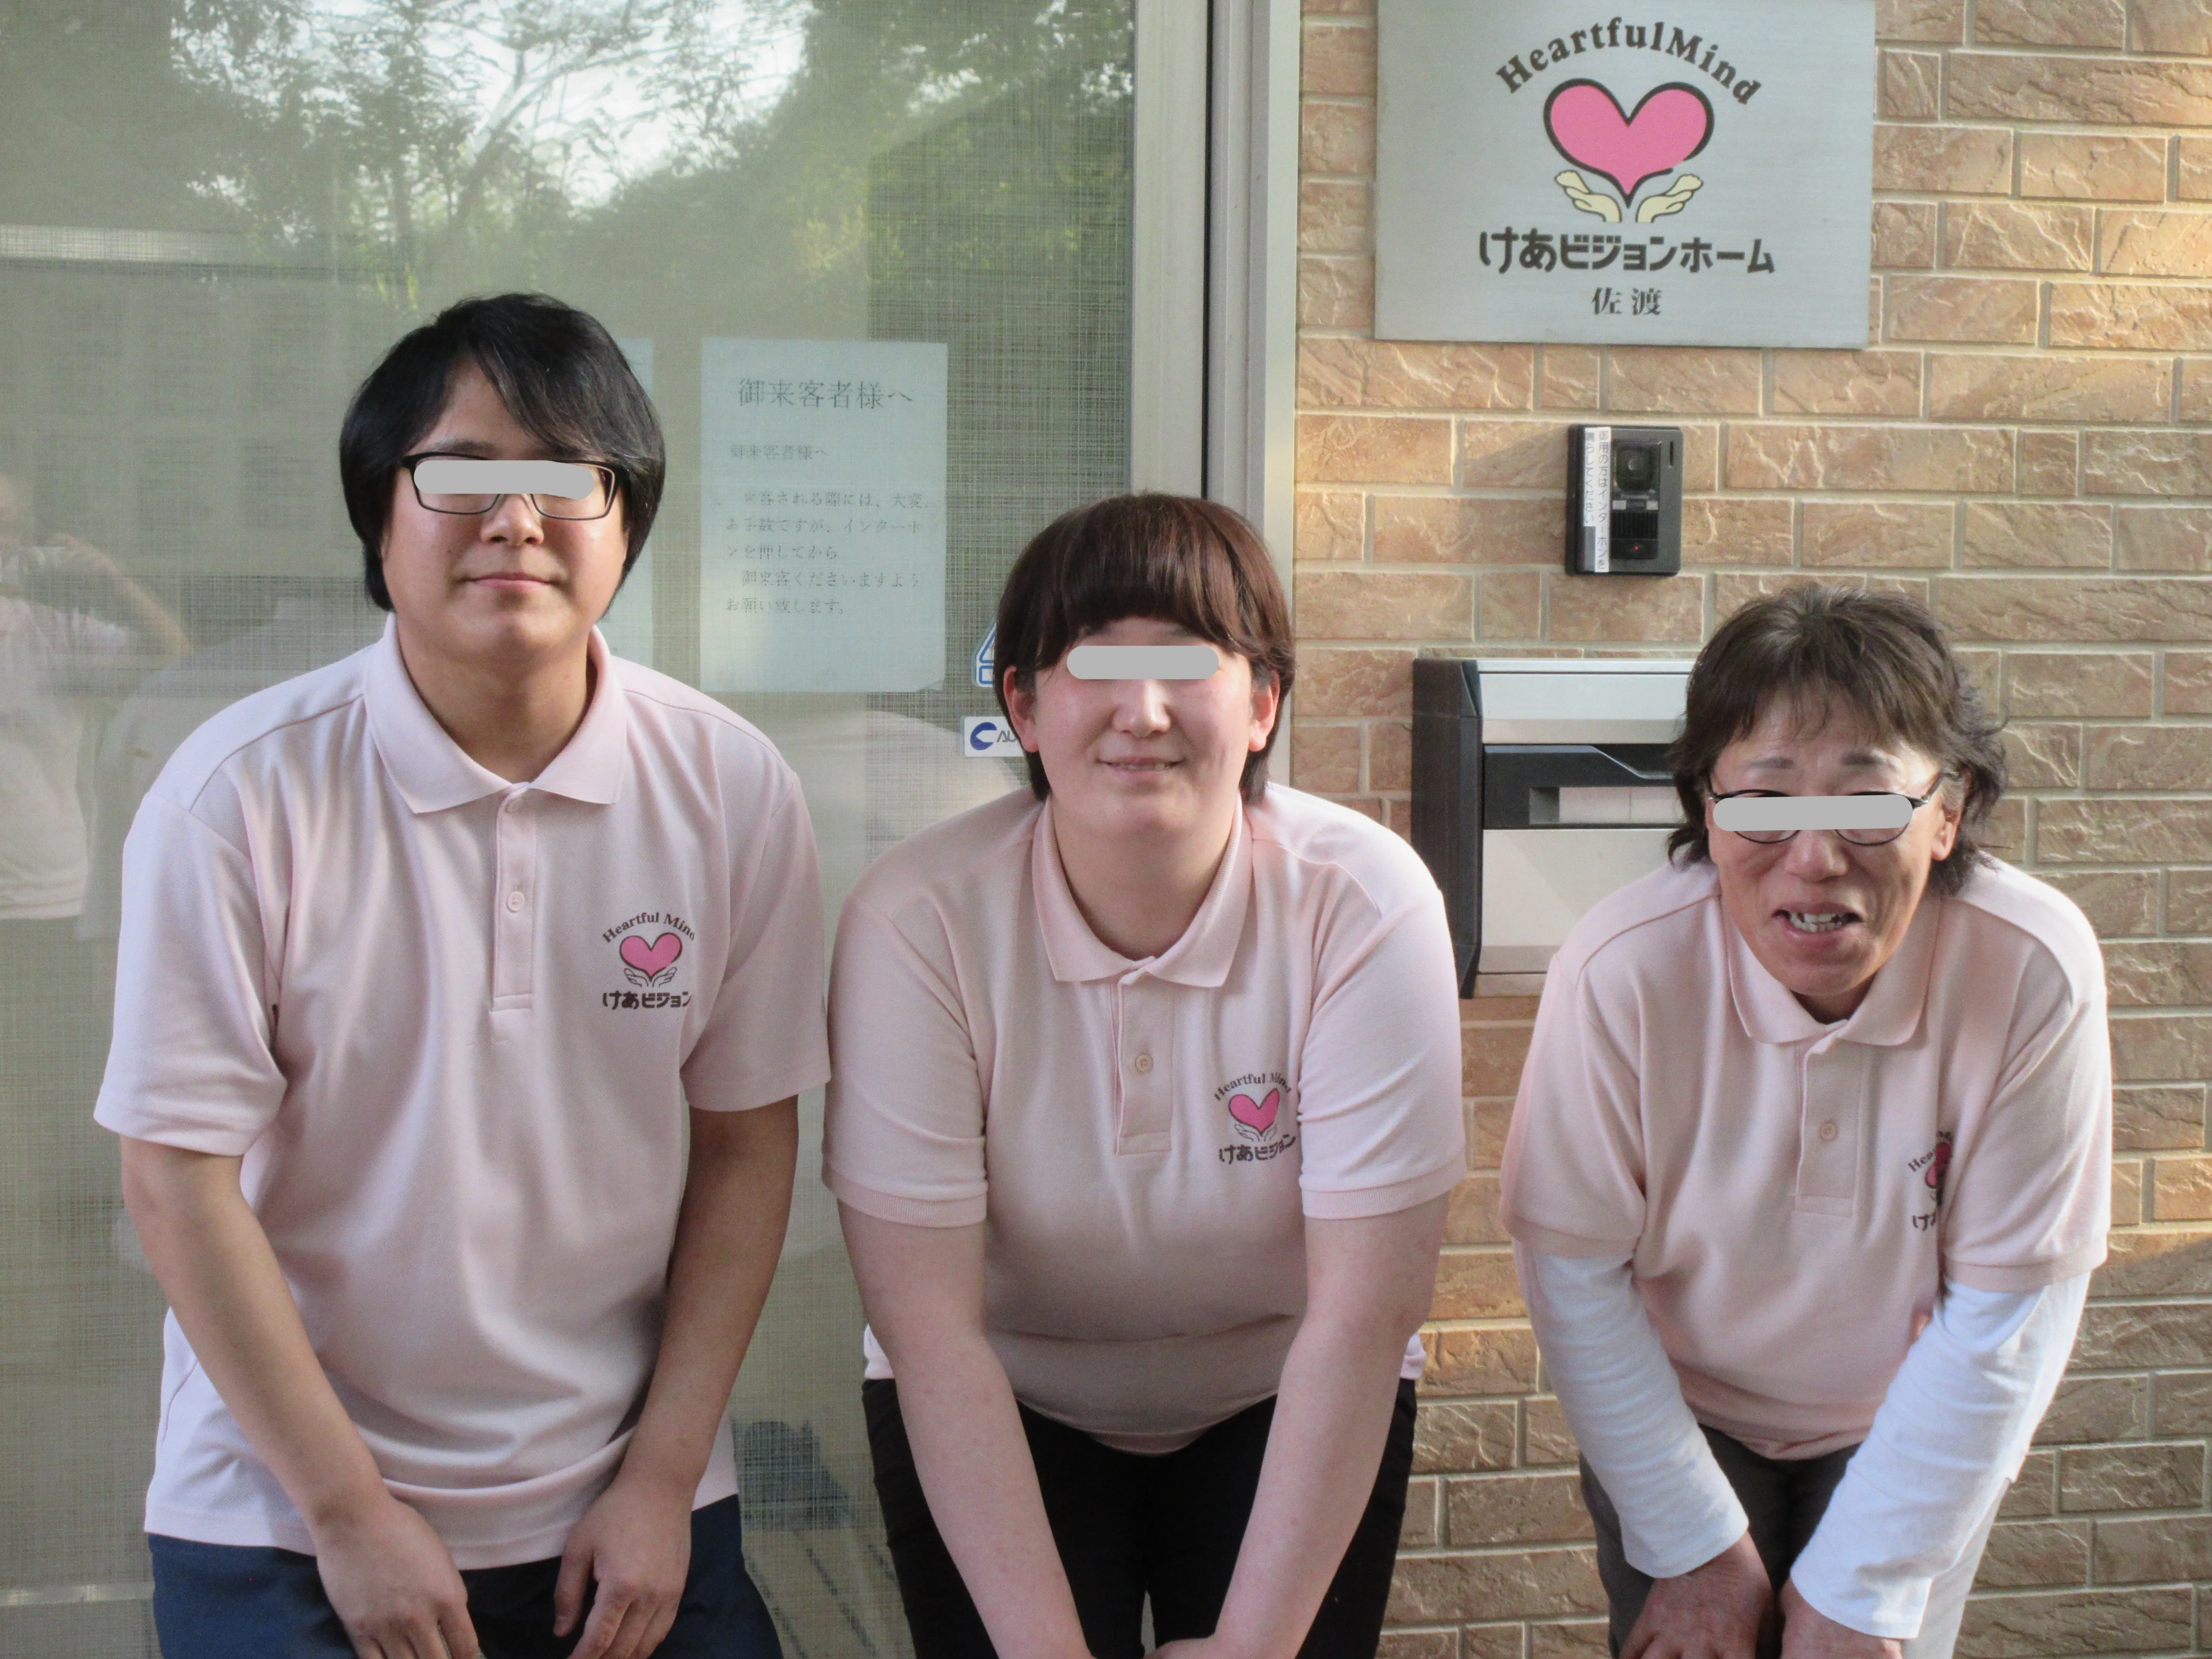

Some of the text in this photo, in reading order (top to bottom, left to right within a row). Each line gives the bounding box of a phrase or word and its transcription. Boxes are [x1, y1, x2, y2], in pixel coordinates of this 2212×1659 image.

[1479, 226, 1775, 274] けあビジョンホーム
[1592, 287, 1662, 316] 佐渡
[738, 378, 913, 410] 御来客者様へ
[602, 912, 660, 943] Heartful
[602, 990, 692, 1010] けあビジョン
[1214, 1074, 1266, 1101] Heartful
